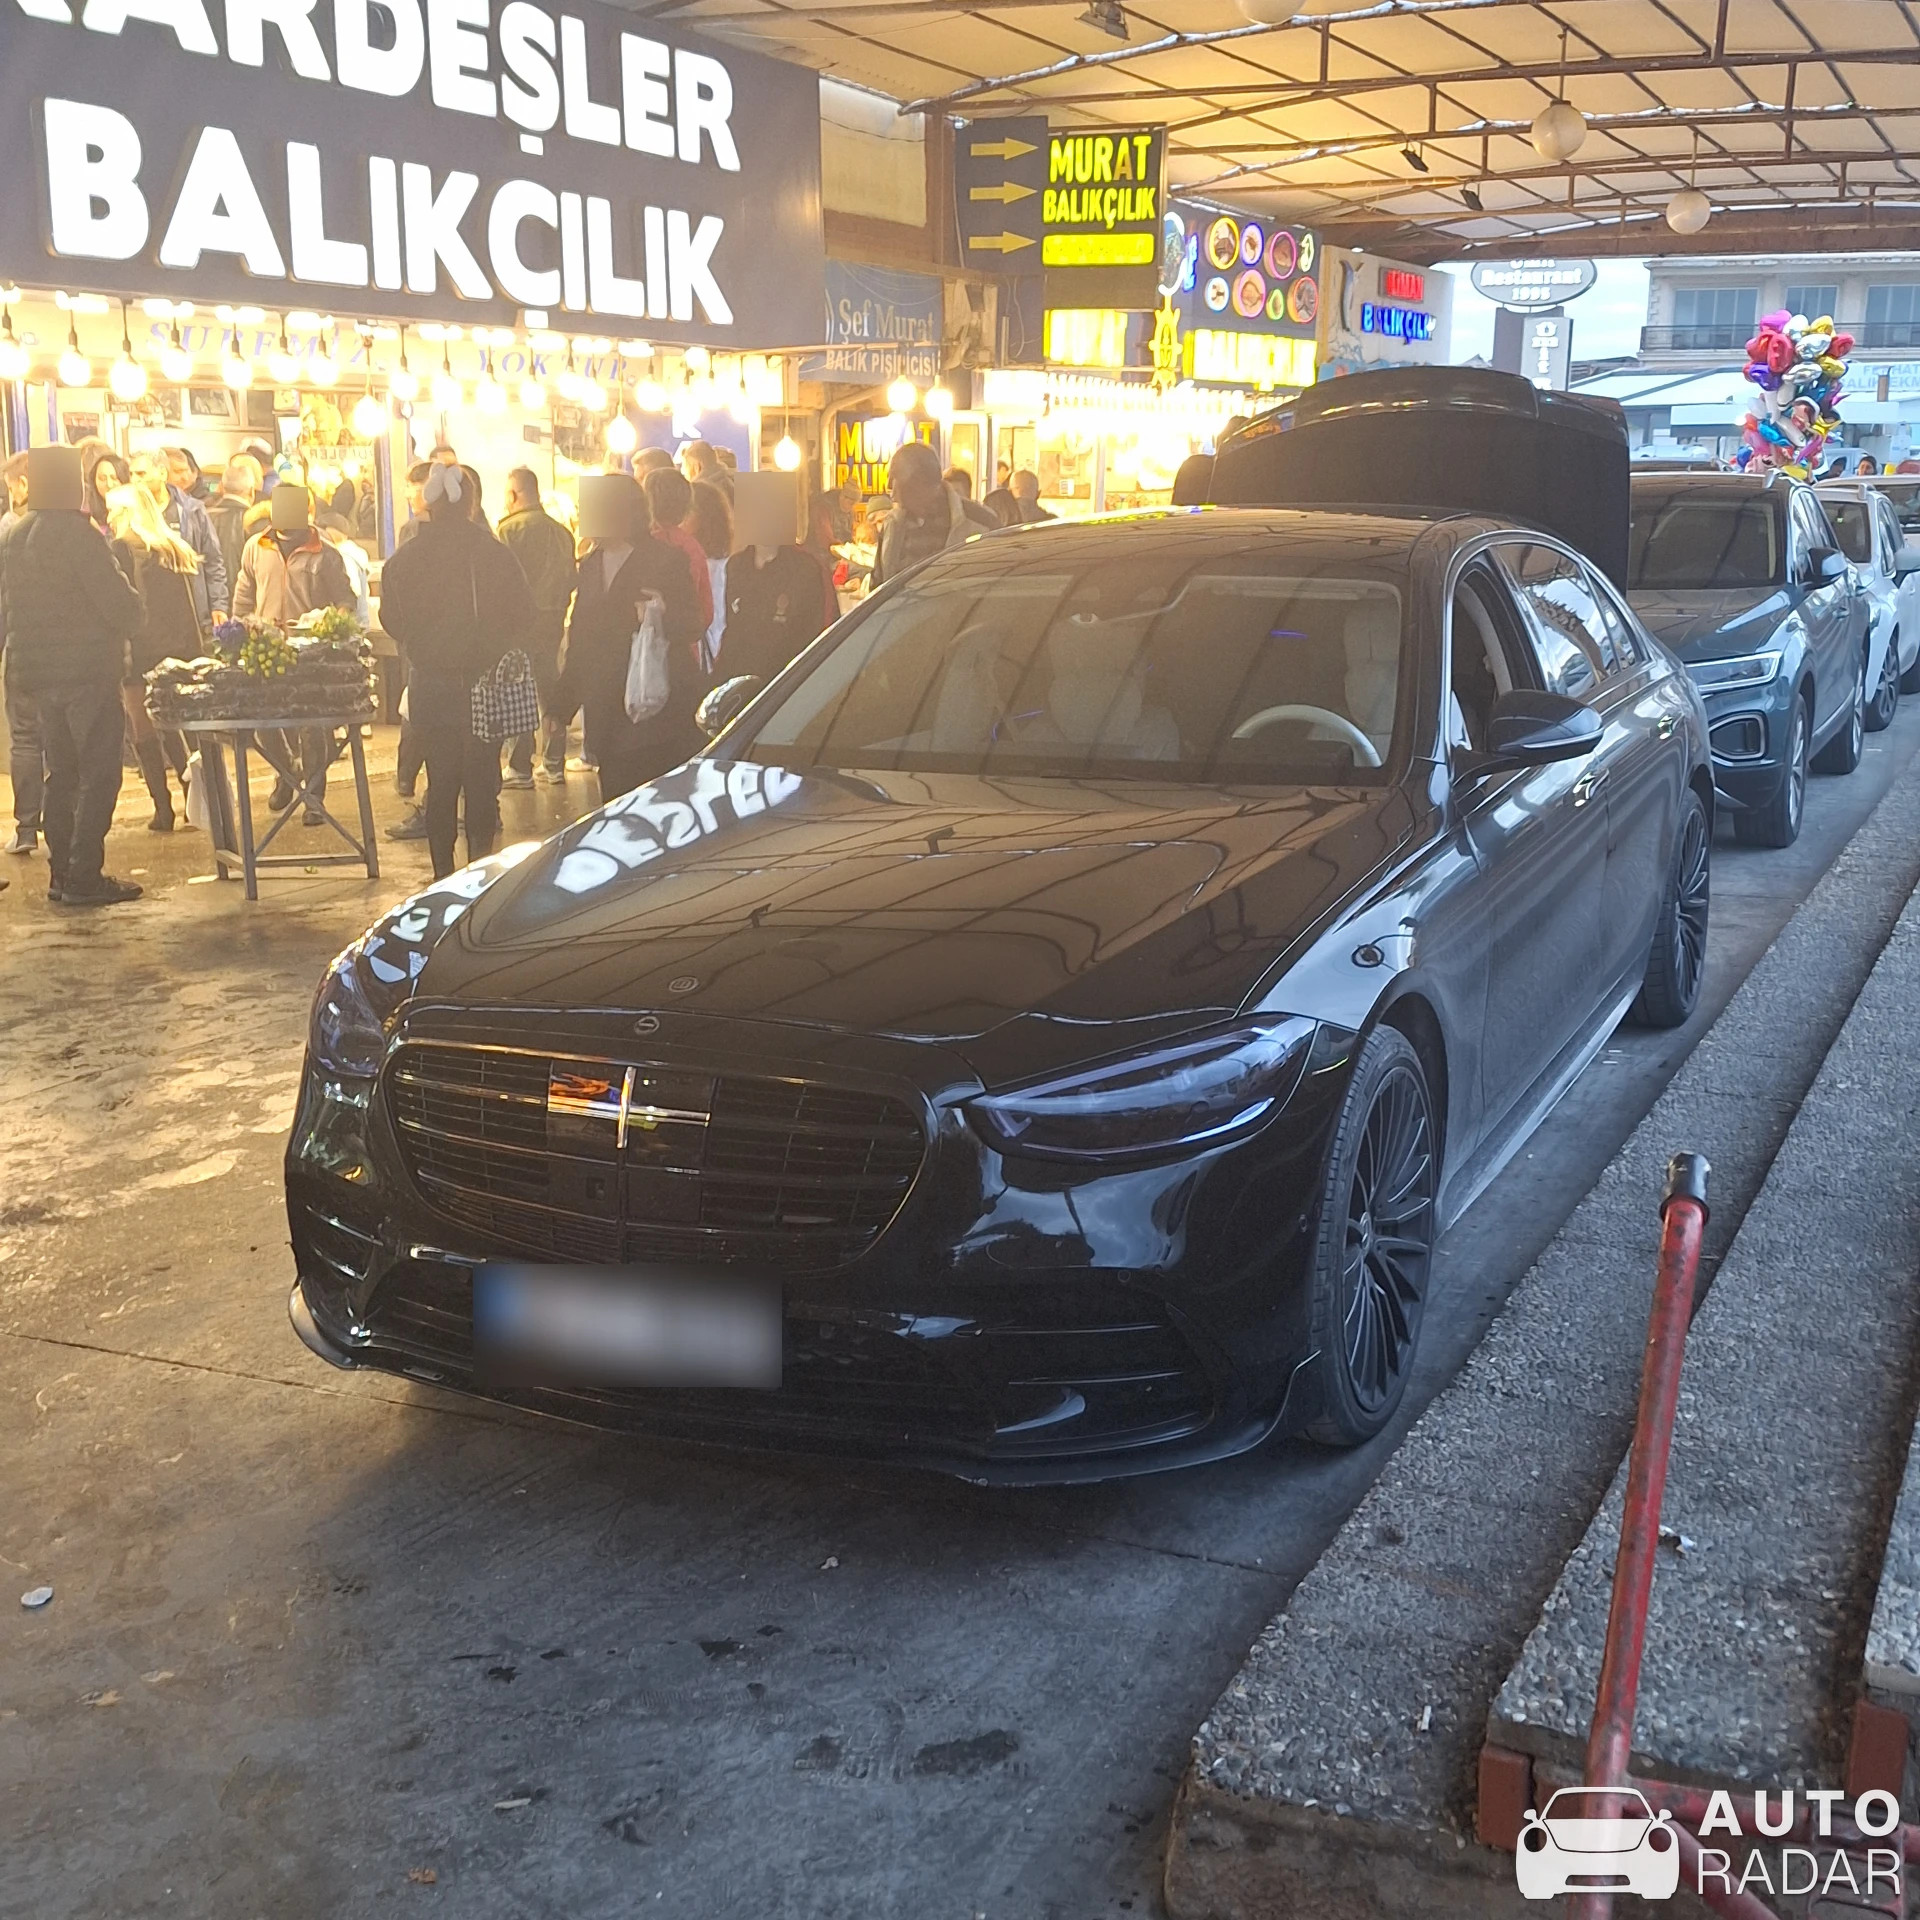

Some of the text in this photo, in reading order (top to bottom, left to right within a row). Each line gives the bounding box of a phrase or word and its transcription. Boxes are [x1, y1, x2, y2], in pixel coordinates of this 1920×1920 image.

[16, 0, 741, 171] RDEŞLER
[1050, 136, 1152, 183] MURAT
[44, 97, 733, 328] BALIKÇILIK
[1043, 187, 1156, 229] BALIKÇILIK
[1480, 268, 1583, 286] Restaurant
[839, 298, 934, 345] Şef Murat
[825, 350, 868, 372] BALIK
